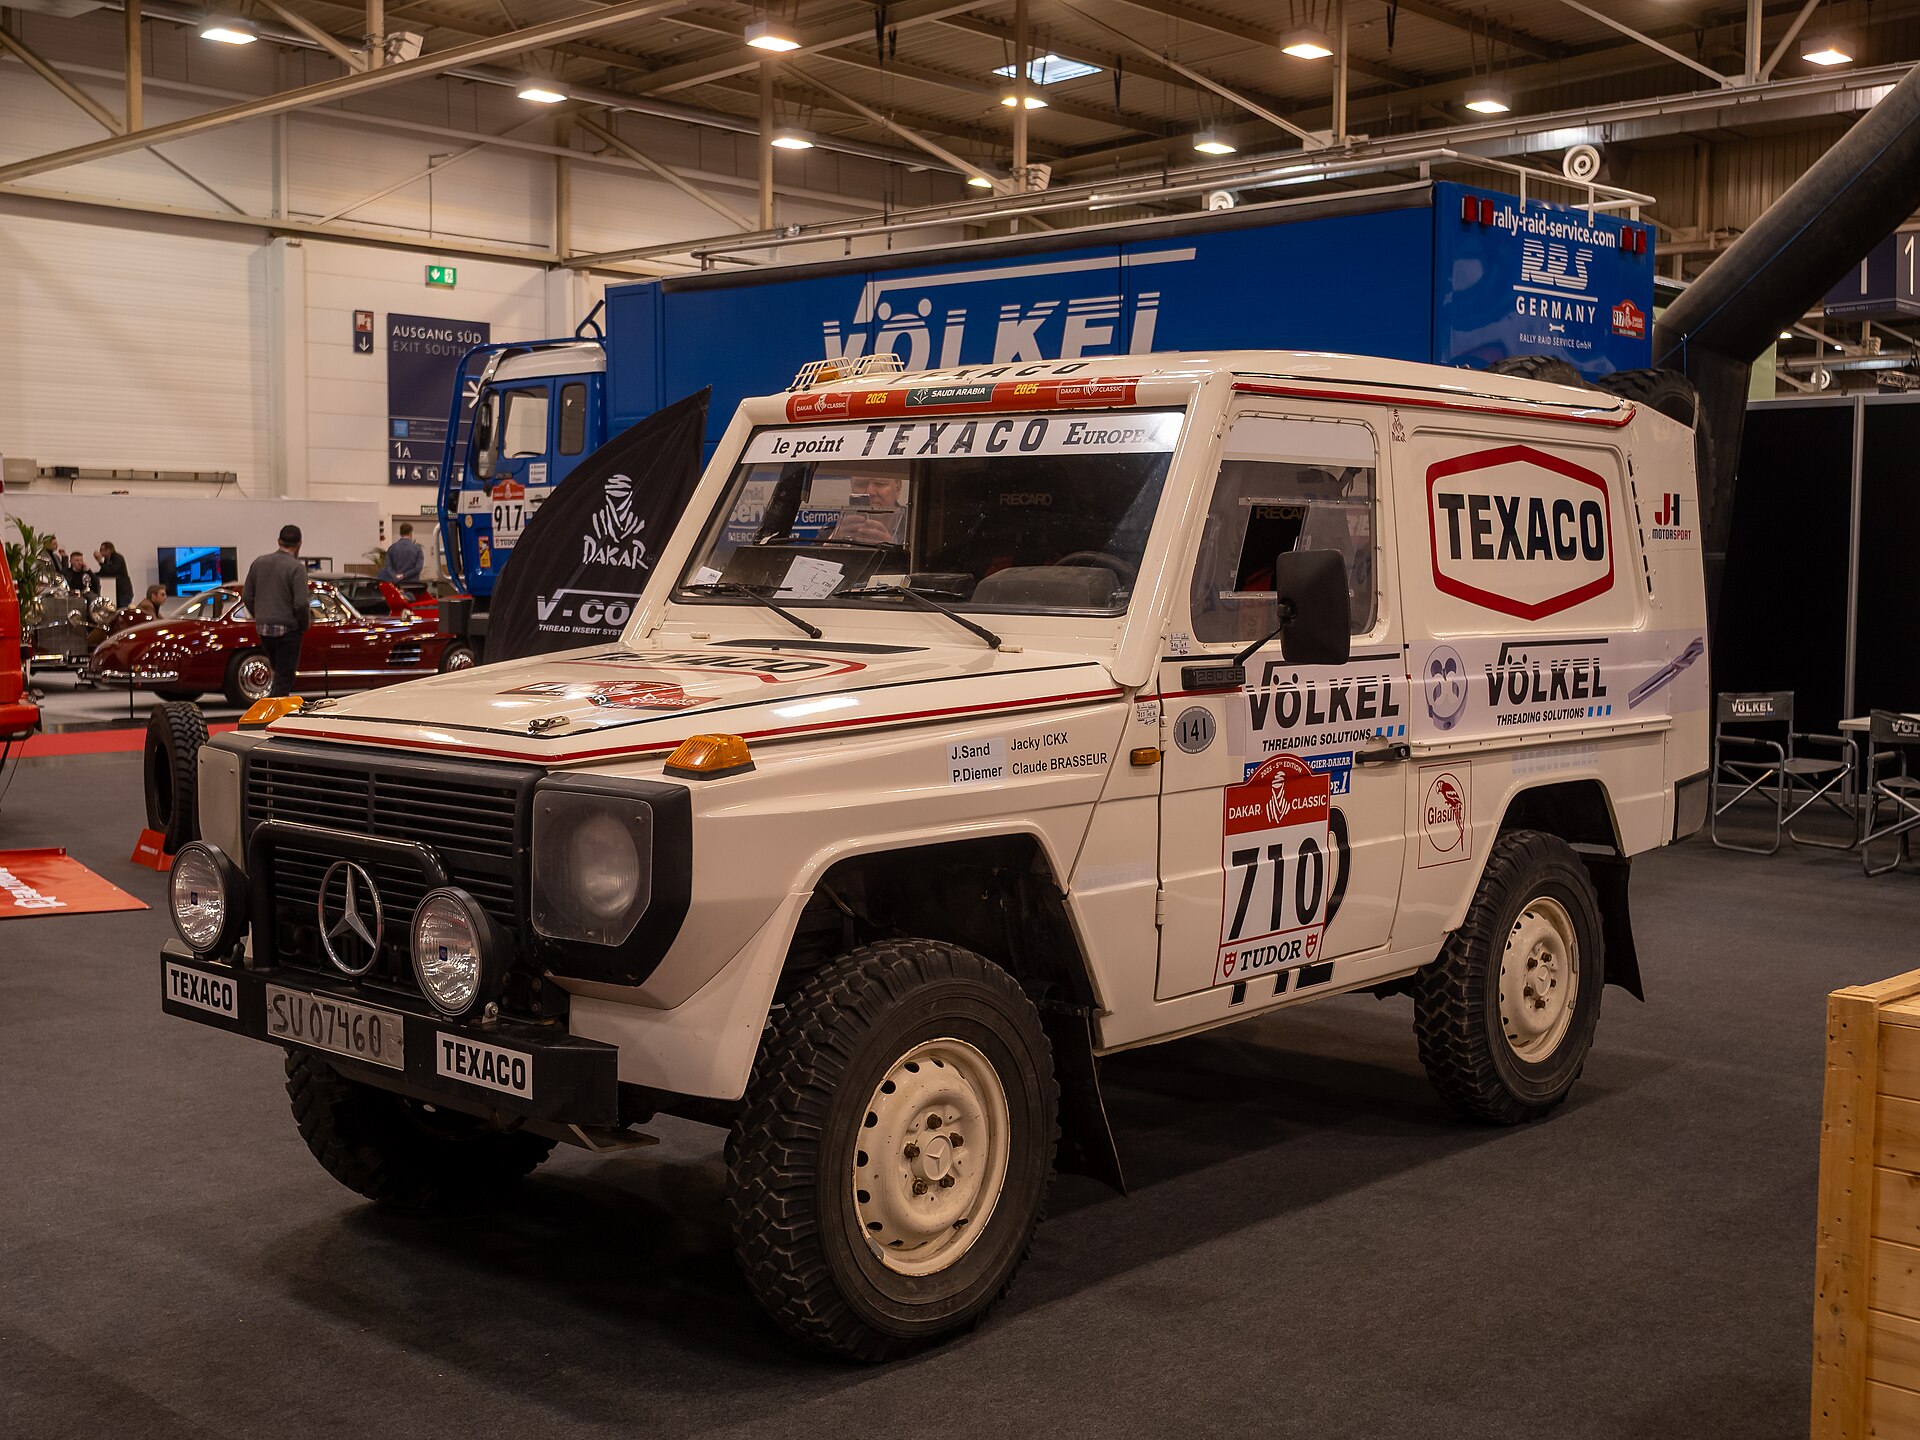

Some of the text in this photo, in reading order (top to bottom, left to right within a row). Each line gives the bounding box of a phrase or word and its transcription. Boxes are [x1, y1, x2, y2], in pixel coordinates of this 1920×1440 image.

[1493, 205, 1616, 248] rally-raid-service.com
[1904, 235, 1915, 295] 1
[1516, 296, 1596, 324] GERMANY
[392, 325, 482, 344] AUSGANG SÜD
[1519, 332, 1537, 344] RALLY
[1537, 335, 1551, 345] RAID
[1552, 337, 1575, 348] SERVICE
[393, 340, 467, 357] EXIT SOUTH
[865, 393, 888, 404] 2025
[931, 387, 986, 398] SAUDI ARABIA
[1013, 383, 1040, 395] 2025
[1060, 387, 1080, 395] DAKAR
[771, 437, 790, 454] le
[791, 435, 845, 458] point
[861, 418, 1050, 457] TEXACO
[1000, 492, 1052, 506] RECARO
[1654, 493, 1681, 526] JH
[494, 505, 523, 531] 917
[1256, 507, 1305, 520] RECA
[1437, 492, 1605, 562] TEXACO
[1652, 528, 1692, 541] MOTORSPORT
[582, 534, 649, 570] DAKAR
[538, 624, 623, 636] THREAD INSERT SYST
[1226, 669, 1243, 680] GE
[1484, 642, 1608, 706] VÖLKEL
[1246, 658, 1400, 731] VÖLKEL
[1731, 698, 1774, 713] VÖLKEL
[1497, 707, 1585, 727] THREADING SOLUTIONS
[1891, 719, 1920, 733] VÖL
[1183, 717, 1207, 744] 141
[1262, 728, 1371, 752] THREADING SOLUTIONS
[951, 742, 990, 760] J.Sand
[1010, 732, 1069, 752] Jacky ICKX
[952, 765, 1003, 783] P.Diemer
[1012, 752, 1108, 775] Claude BRASSEUR
[1260, 765, 1273, 779] 2025
[1283, 760, 1302, 773] EDITION
[1340, 771, 1348, 793] 1
[1228, 794, 1327, 820] DAKAR CLASSIC
[1427, 804, 1463, 825] Glasurit
[1228, 837, 1324, 941] 710
[1240, 939, 1301, 972] TUDOR
[170, 967, 234, 1012] TEXACO
[272, 993, 382, 1058] SU 07460
[441, 1039, 526, 1092] TEXACO
